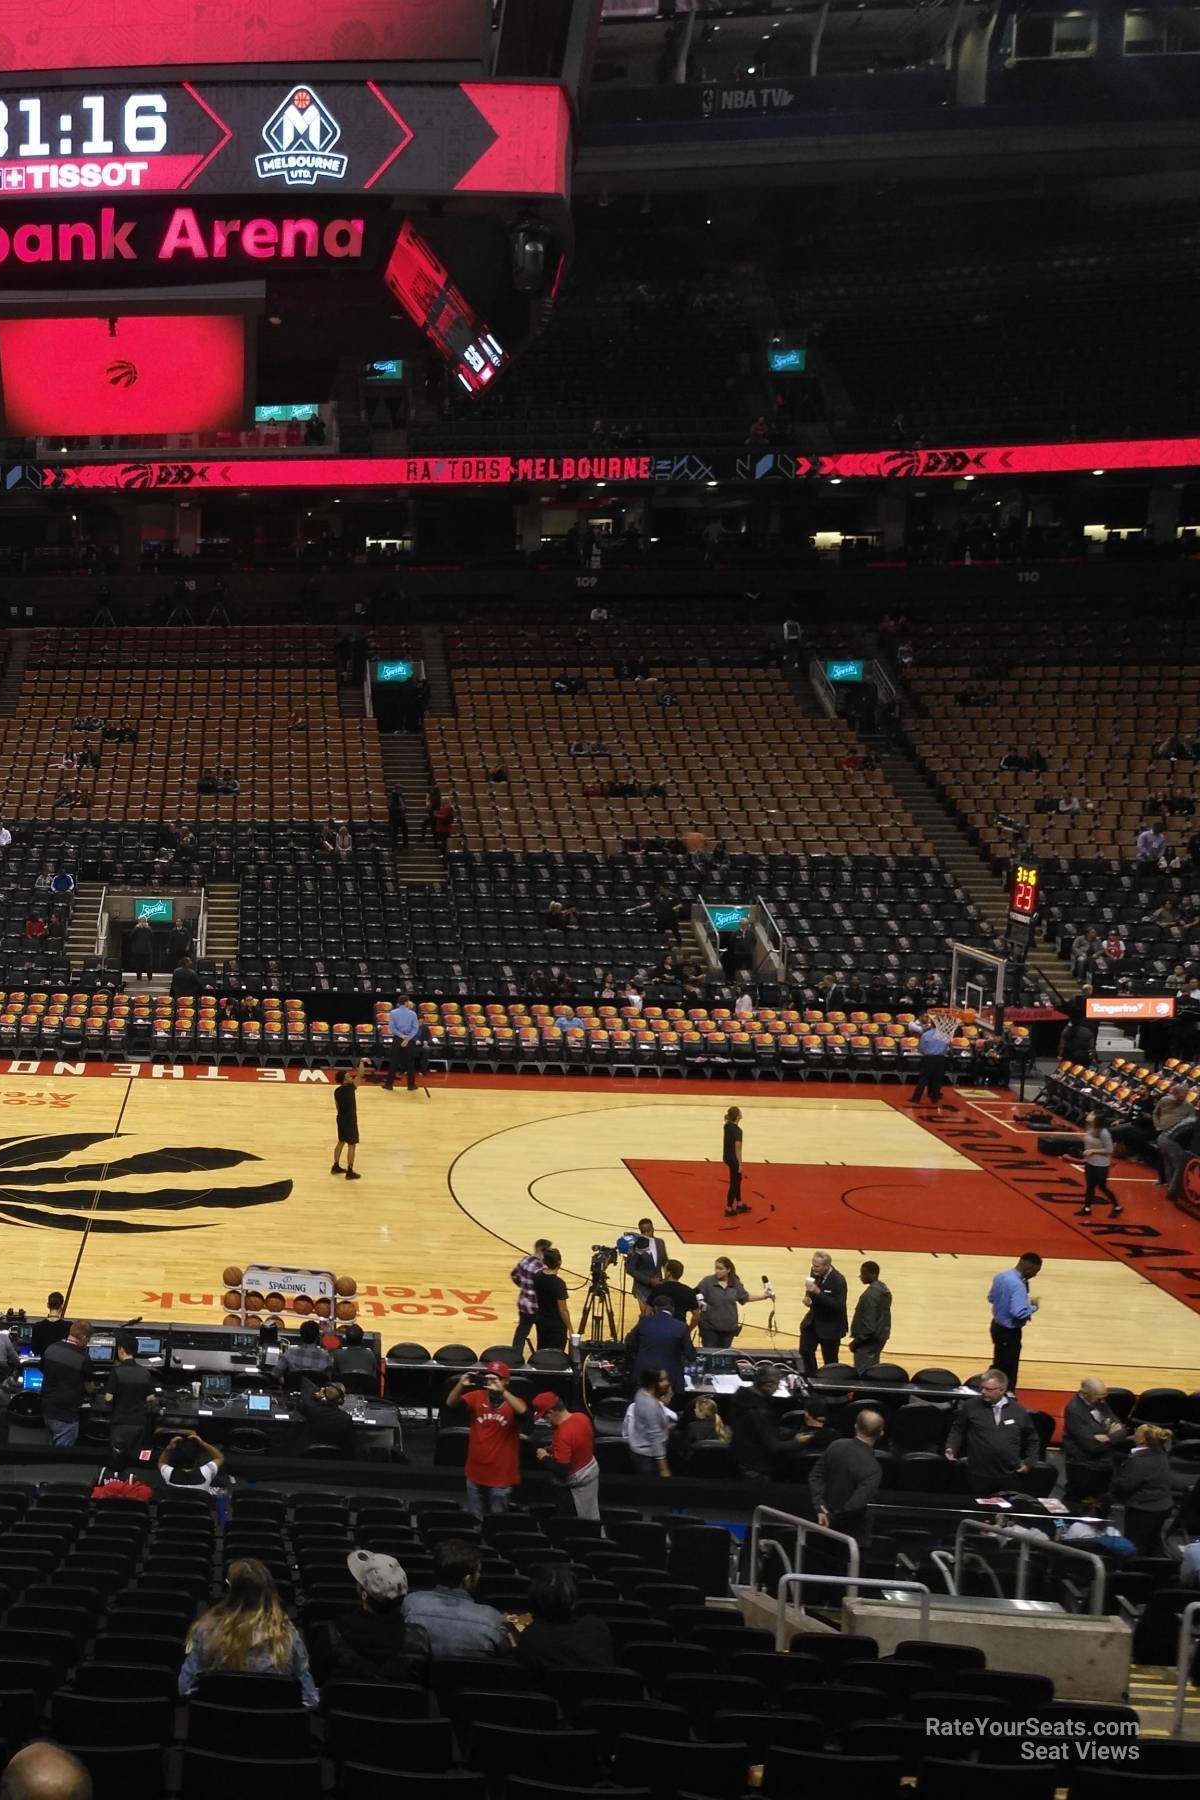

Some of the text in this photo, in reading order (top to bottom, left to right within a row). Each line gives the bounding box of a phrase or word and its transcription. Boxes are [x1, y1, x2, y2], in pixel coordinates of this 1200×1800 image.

[721, 90, 757, 109] NBA
[263, 155, 340, 172] MELBOURNE
[26, 162, 148, 189] TISSOT
[158, 208, 365, 259] Arena
[518, 456, 651, 480] MELBOURNE
[576, 576, 597, 587] 109
[1017, 572, 1040, 583] 110
[1016, 883, 1032, 910] 23
[1091, 1001, 1138, 1014] Tangerine
[111, 1063, 229, 1080] THE
[256, 1067, 330, 1084] WE
[268, 1280, 307, 1293] SPALDING
